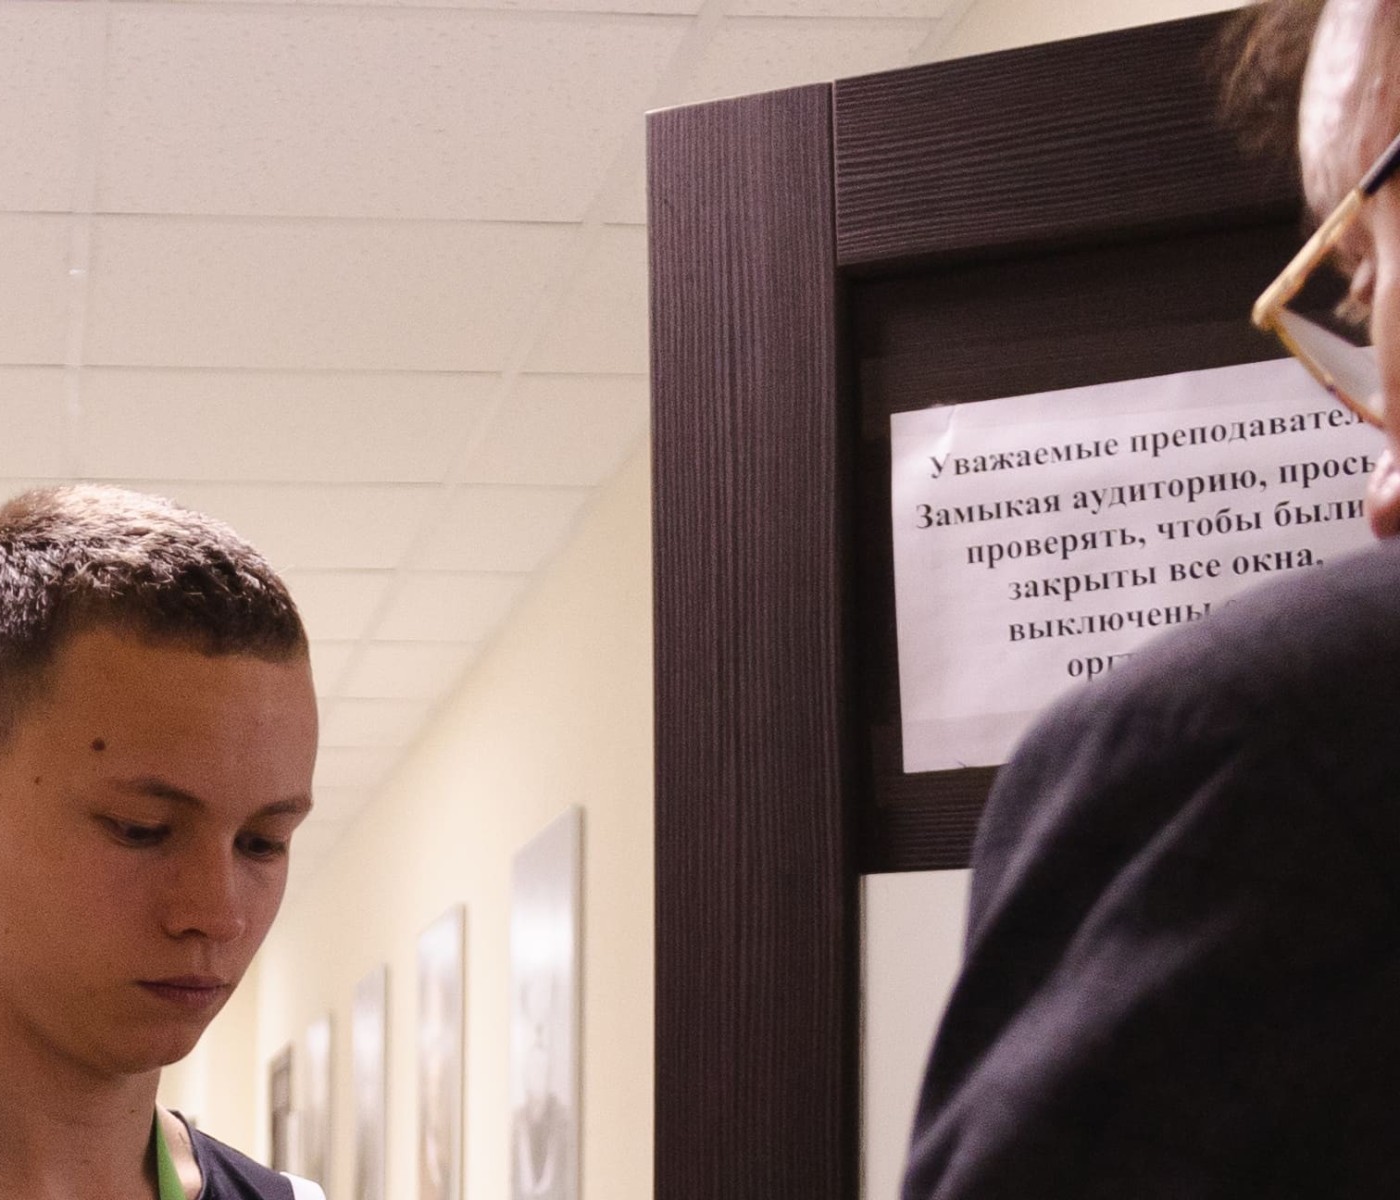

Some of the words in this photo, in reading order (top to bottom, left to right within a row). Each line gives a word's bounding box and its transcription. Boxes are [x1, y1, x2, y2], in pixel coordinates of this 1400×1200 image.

[930, 437, 1119, 479] Уважаемые
[1130, 407, 1365, 458] преподавател
[915, 494, 1061, 530] Замыкая
[1073, 468, 1268, 515] аудиторию,
[1279, 454, 1377, 489] прось
[966, 527, 1147, 569] проверять,
[1157, 508, 1263, 541] чтобы
[1274, 499, 1364, 528] были
[1008, 566, 1156, 601] закрыты
[1169, 557, 1222, 582] все
[1008, 602, 1212, 642] выключены
